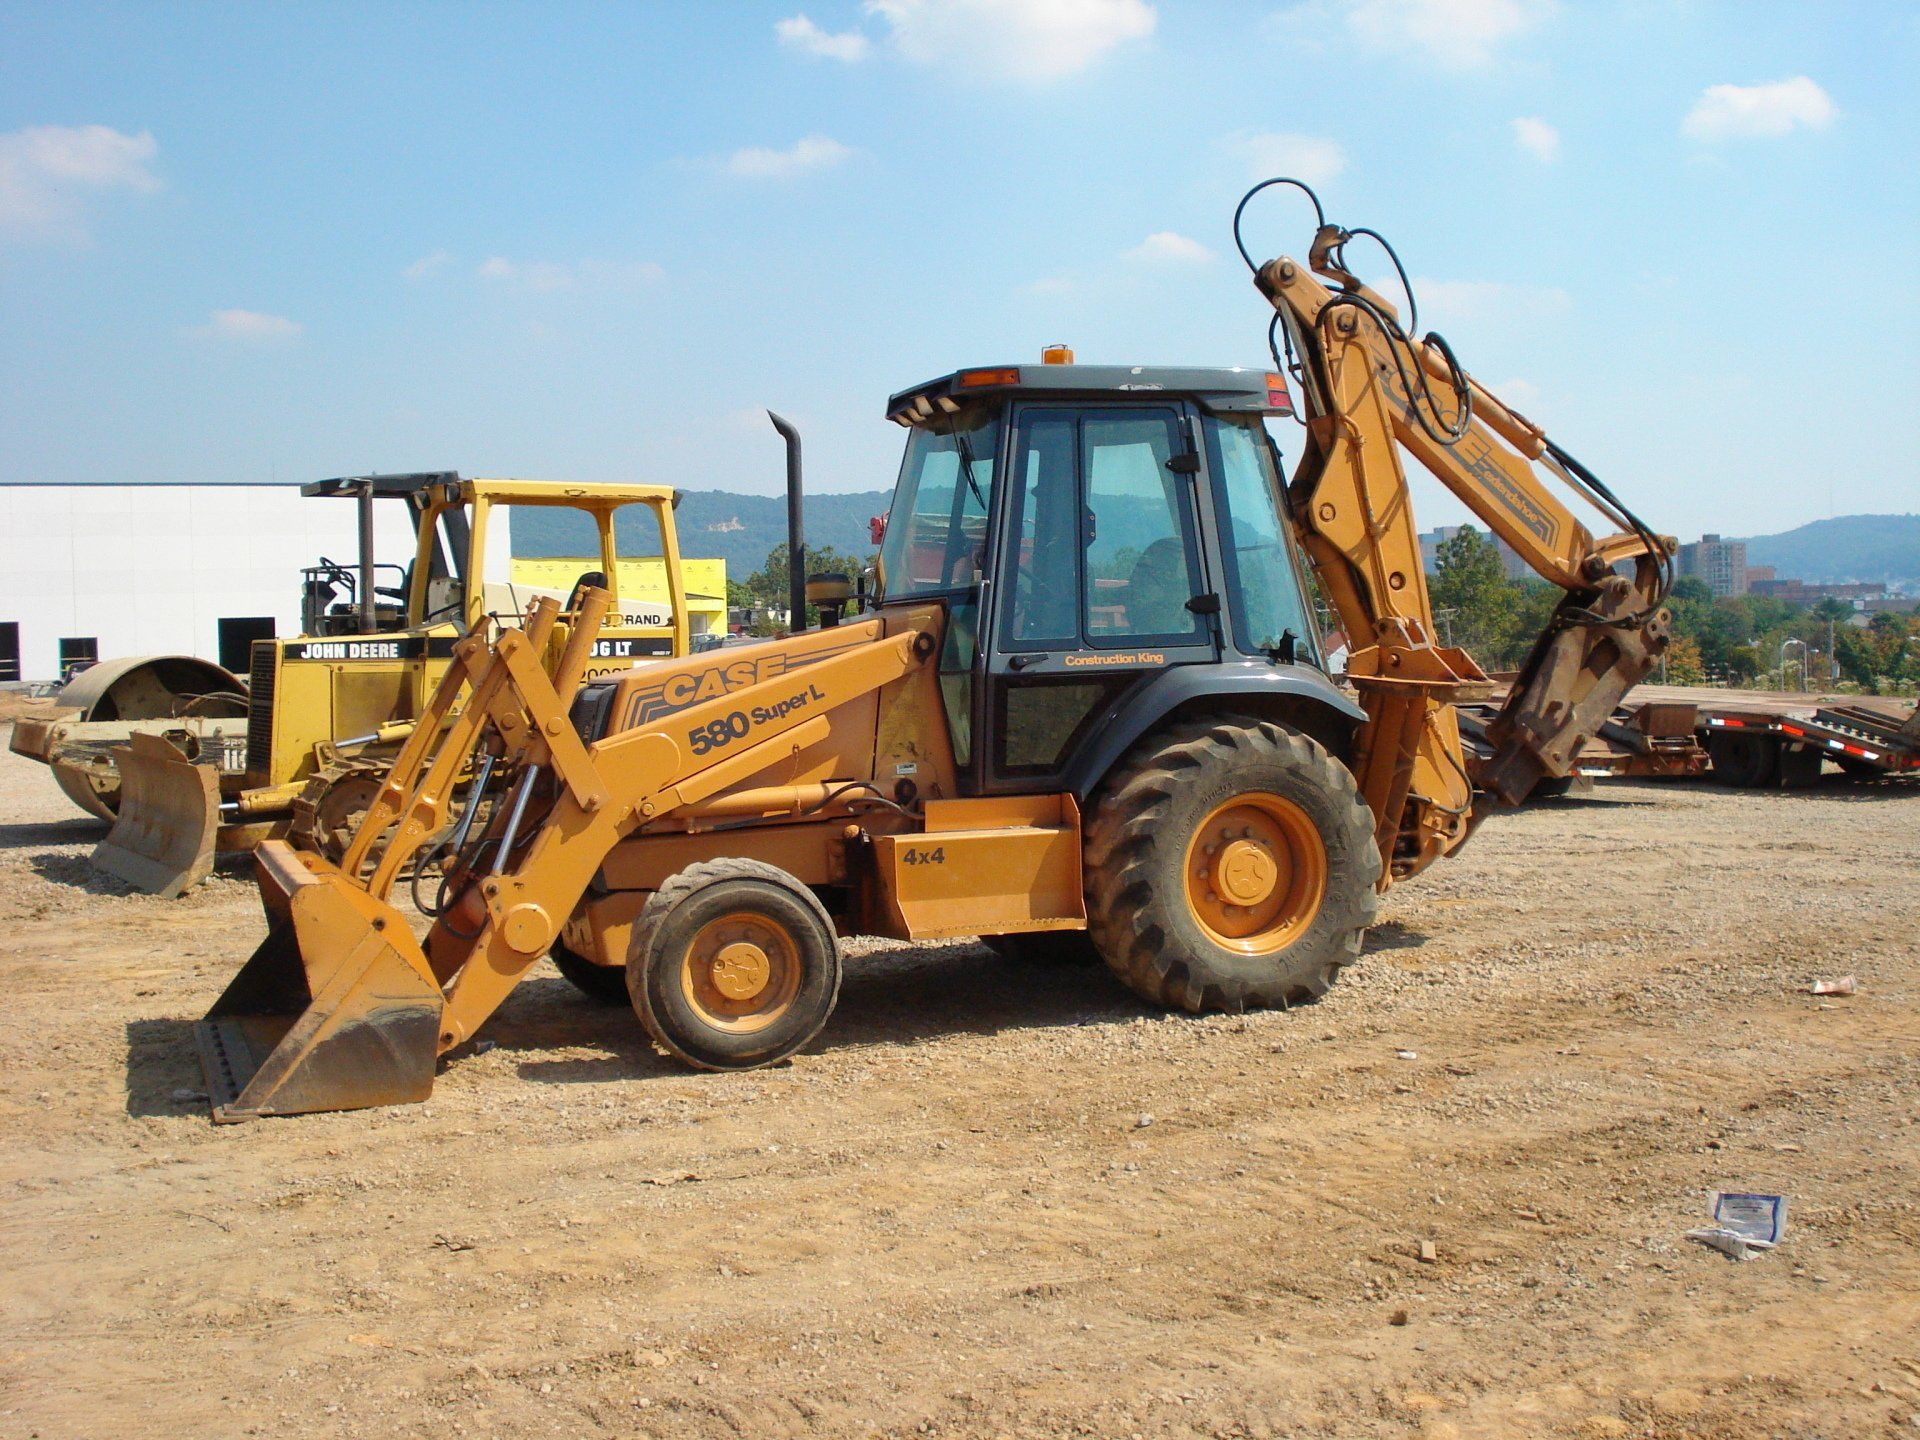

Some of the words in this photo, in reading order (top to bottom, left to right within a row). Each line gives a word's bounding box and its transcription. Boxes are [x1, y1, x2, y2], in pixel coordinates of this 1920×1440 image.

[300, 643, 346, 659] JOHN
[349, 643, 399, 658] DEERE
[616, 641, 632, 656] LT
[1065, 654, 1136, 666] Construction
[1138, 652, 1164, 664] King
[662, 653, 786, 706] CASE
[688, 711, 750, 756] 580
[751, 691, 809, 725] Super
[809, 684, 826, 701] L
[903, 846, 945, 866] 4x4
